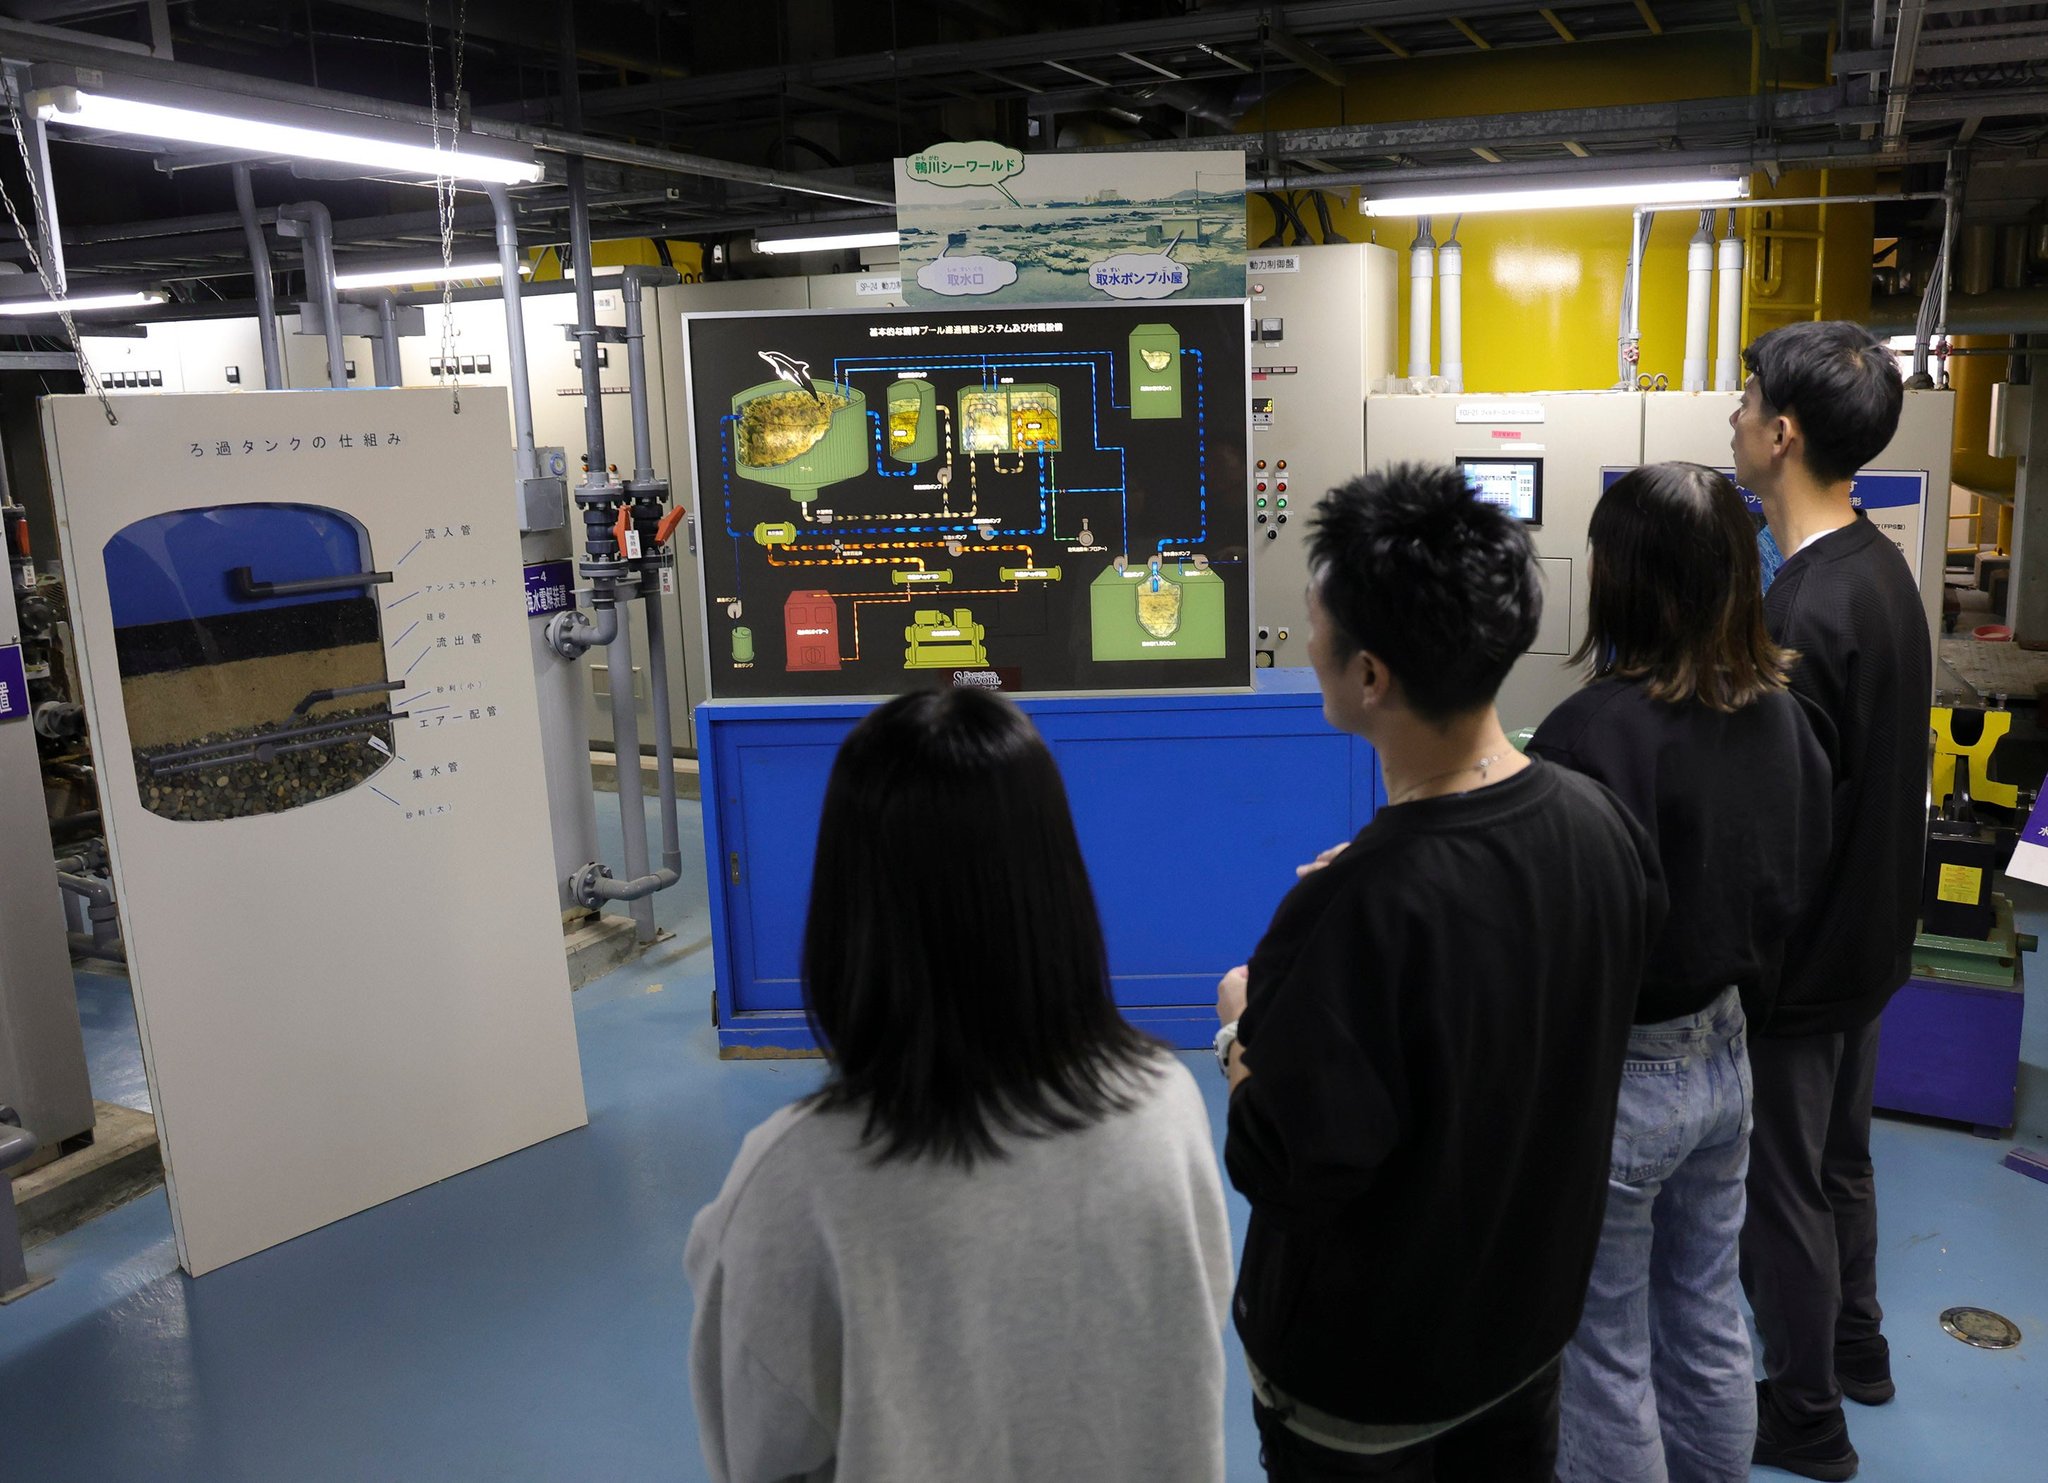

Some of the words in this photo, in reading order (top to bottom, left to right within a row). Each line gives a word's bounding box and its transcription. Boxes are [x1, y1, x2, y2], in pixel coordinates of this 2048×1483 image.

[914, 159, 1015, 174] 鴨川シーワールド
[1249, 258, 1294, 270] 動力制御盤
[947, 273, 984, 287] 取水口
[1096, 271, 1183, 286] 取水ポンプ小屋
[190, 432, 401, 457] ろ過タンクの仕組み
[424, 524, 471, 540] 流入管
[425, 578, 497, 593] アンスラサイト
[436, 633, 482, 648] 流出管
[419, 705, 497, 728] エアー配管
[412, 761, 458, 780] 集水管
